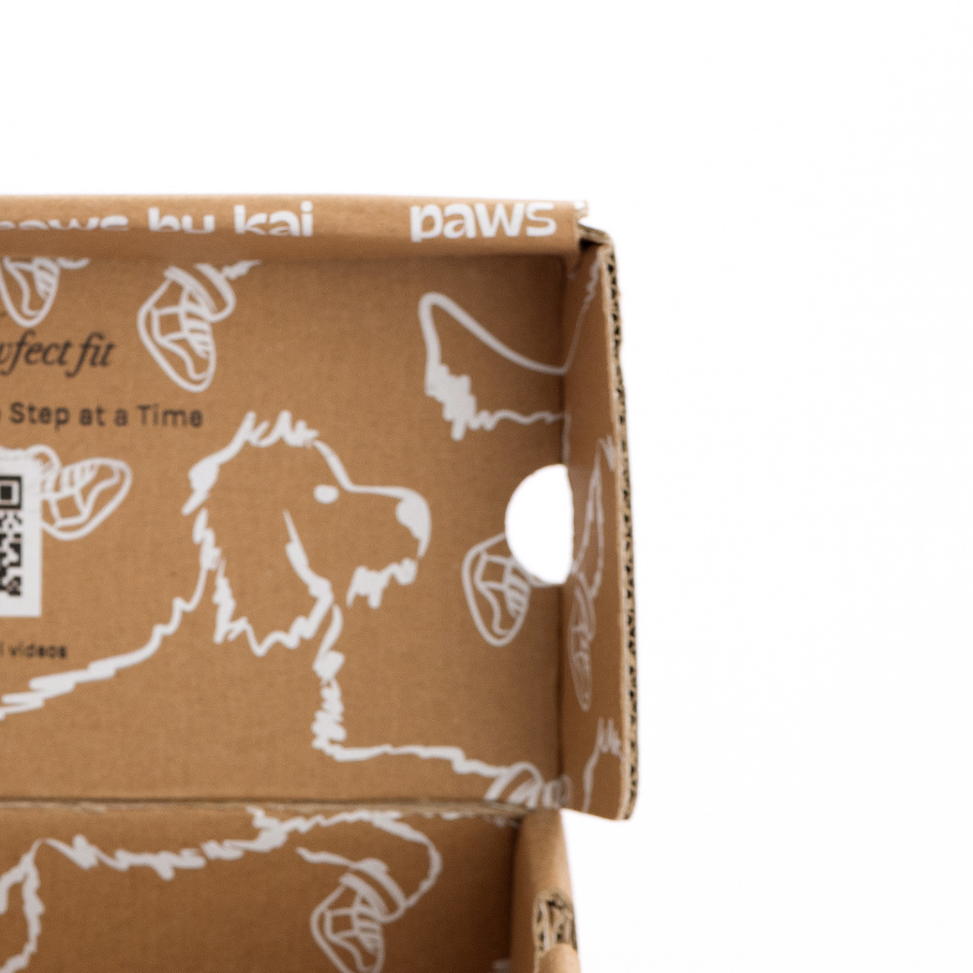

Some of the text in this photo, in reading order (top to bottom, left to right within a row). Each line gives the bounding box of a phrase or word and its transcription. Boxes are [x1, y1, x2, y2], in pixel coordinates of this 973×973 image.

[234, 200, 313, 237] kai
[410, 202, 557, 242] paws
[64, 331, 115, 378] fit
[9, 401, 70, 431] Step
[79, 404, 106, 426] at
[113, 407, 128, 427] a
[137, 402, 204, 427] Time
[8, 640, 69, 660] videos
